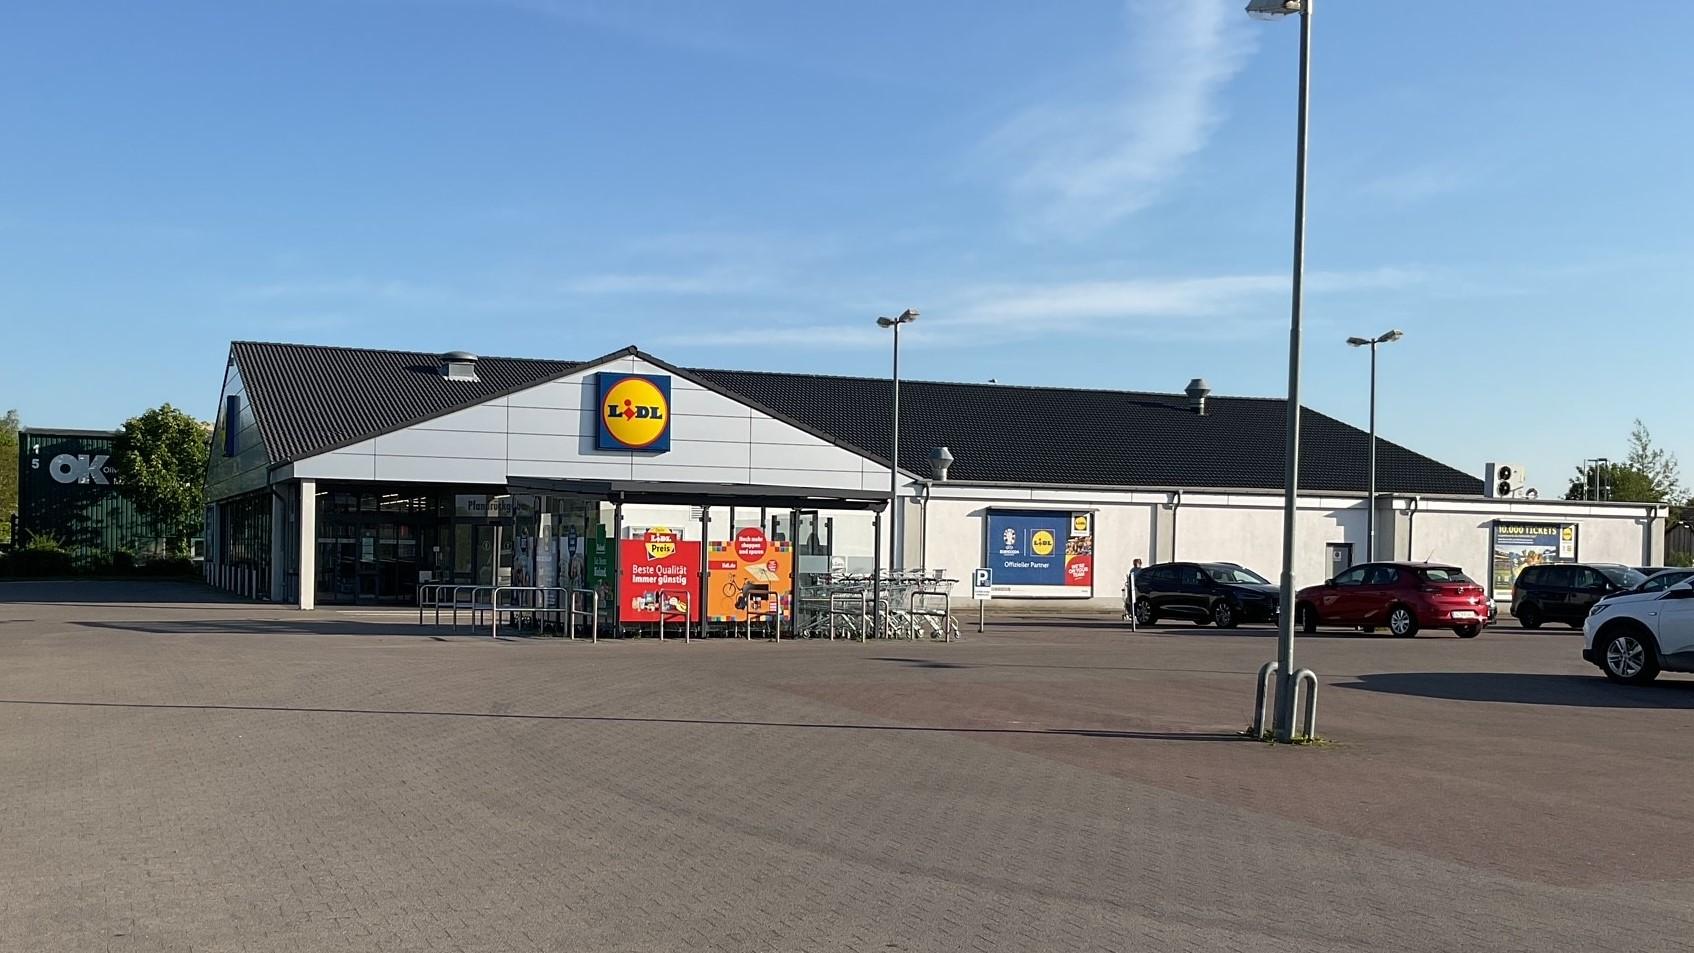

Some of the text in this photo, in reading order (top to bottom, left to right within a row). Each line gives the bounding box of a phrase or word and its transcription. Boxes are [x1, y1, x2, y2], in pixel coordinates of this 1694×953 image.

[31, 458, 39, 469] 5
[50, 453, 110, 485] OK
[651, 544, 670, 552] Preis
[632, 565, 687, 577] Beste Qualität
[632, 575, 687, 585] Immer günstig
[976, 570, 989, 586] P
